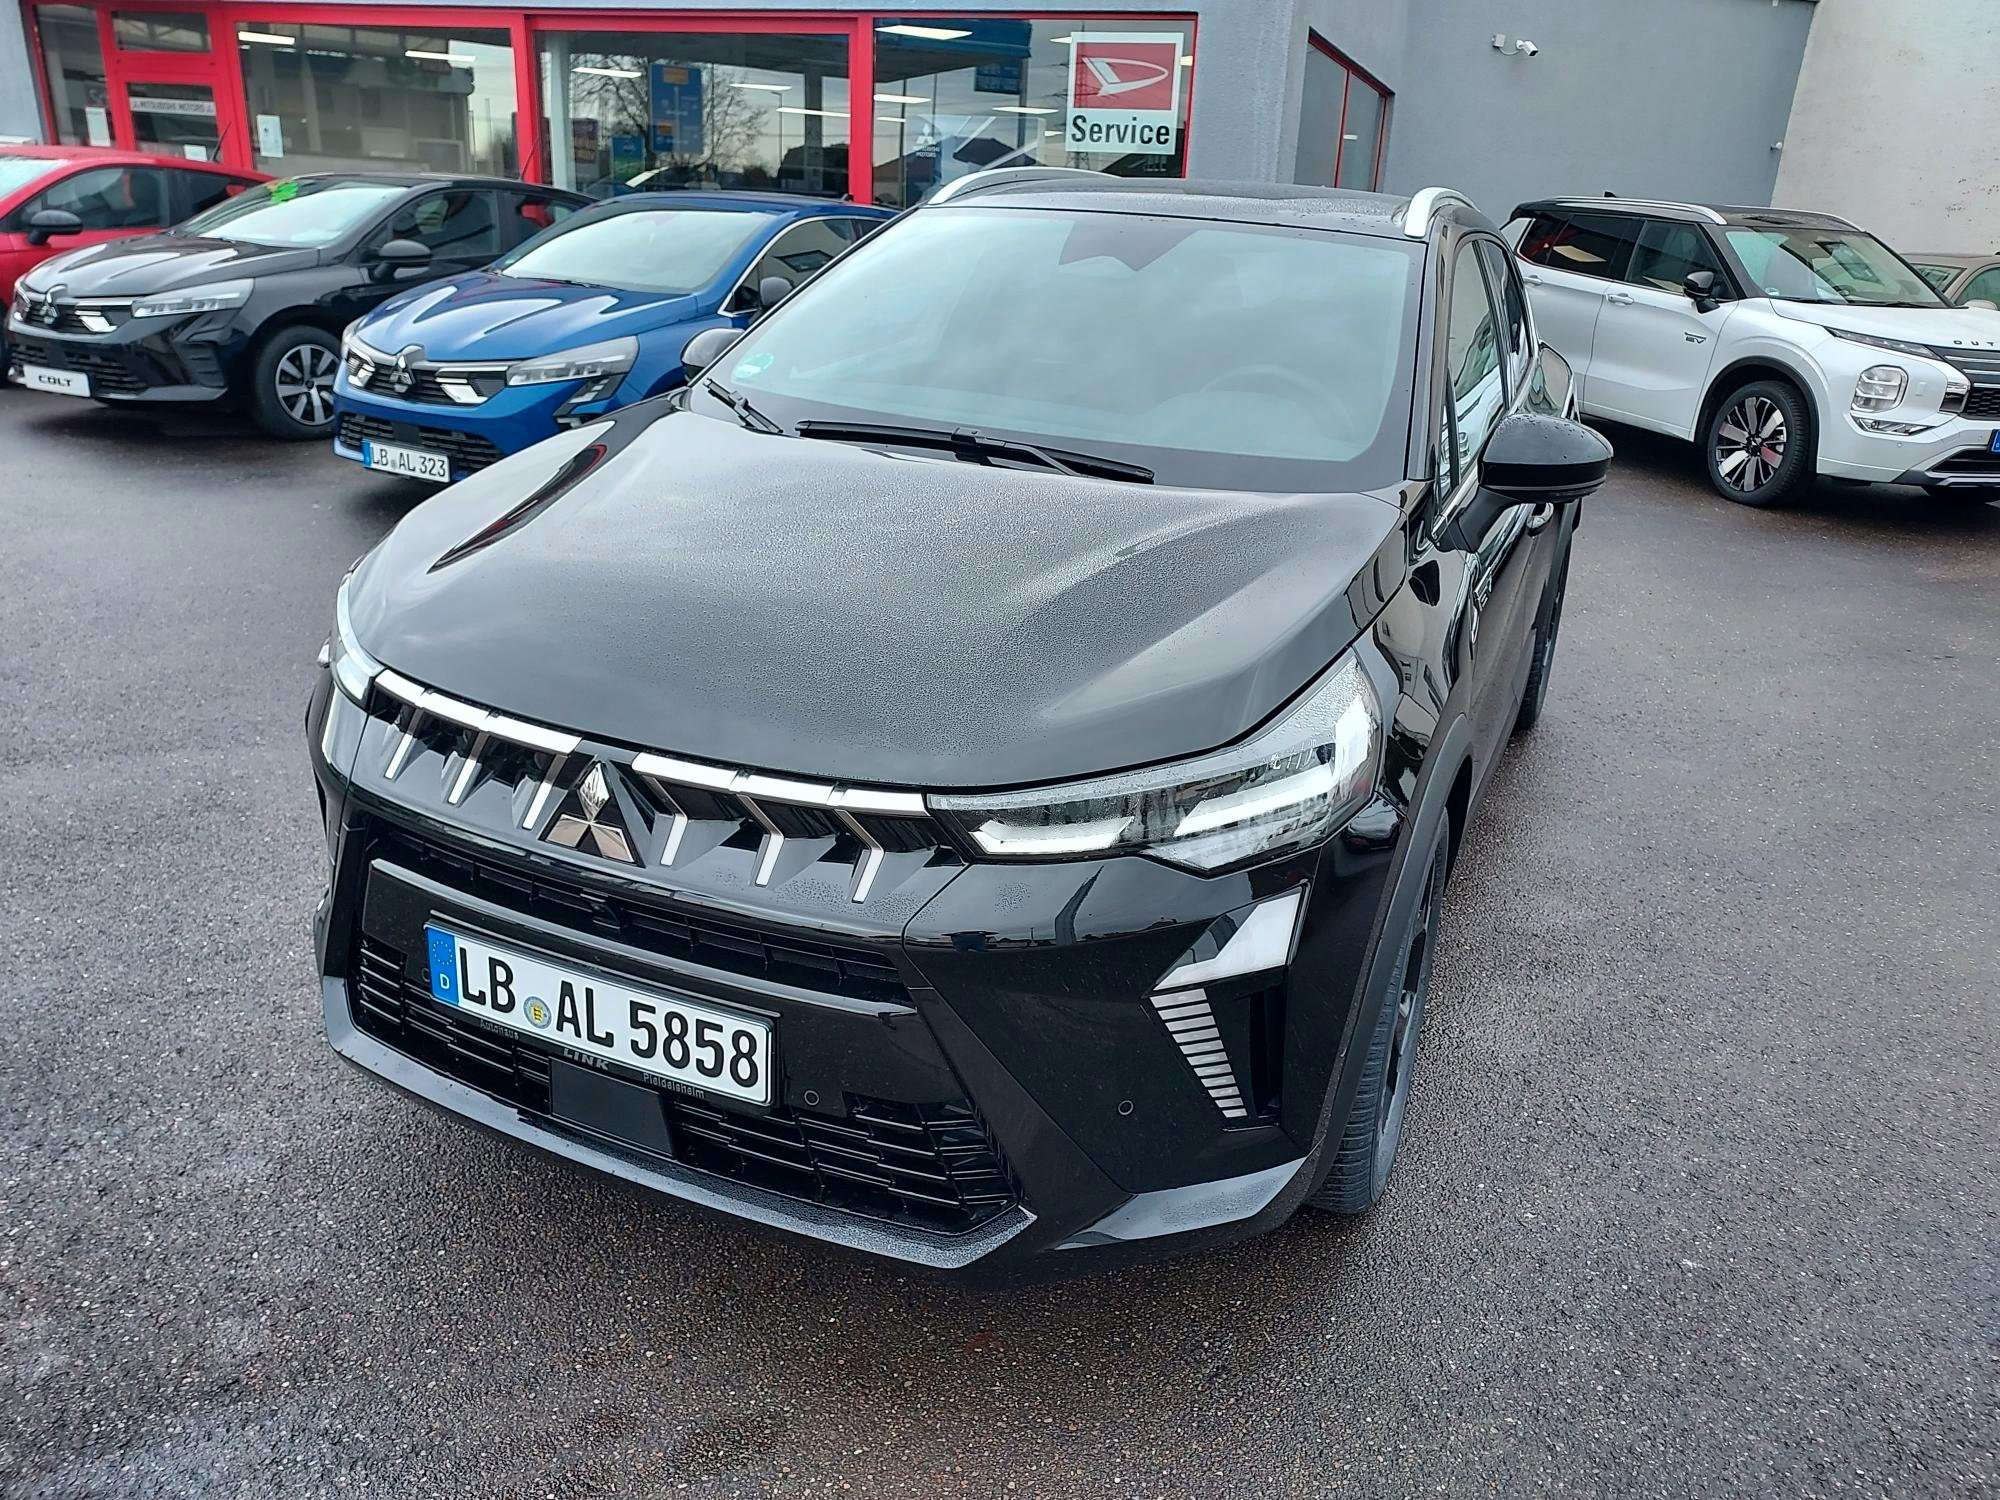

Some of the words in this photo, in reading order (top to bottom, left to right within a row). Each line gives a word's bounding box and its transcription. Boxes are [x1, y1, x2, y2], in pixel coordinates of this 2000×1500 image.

[1071, 114, 1170, 145] Service
[38, 375, 71, 387] COLT
[371, 446, 388, 467] LB
[399, 452, 416, 472] AL
[419, 455, 446, 478] 323
[440, 973, 449, 989] D
[459, 946, 516, 1014] LB
[556, 979, 614, 1049] AL
[629, 999, 759, 1089] 5858
[563, 1048, 609, 1071] LINK
